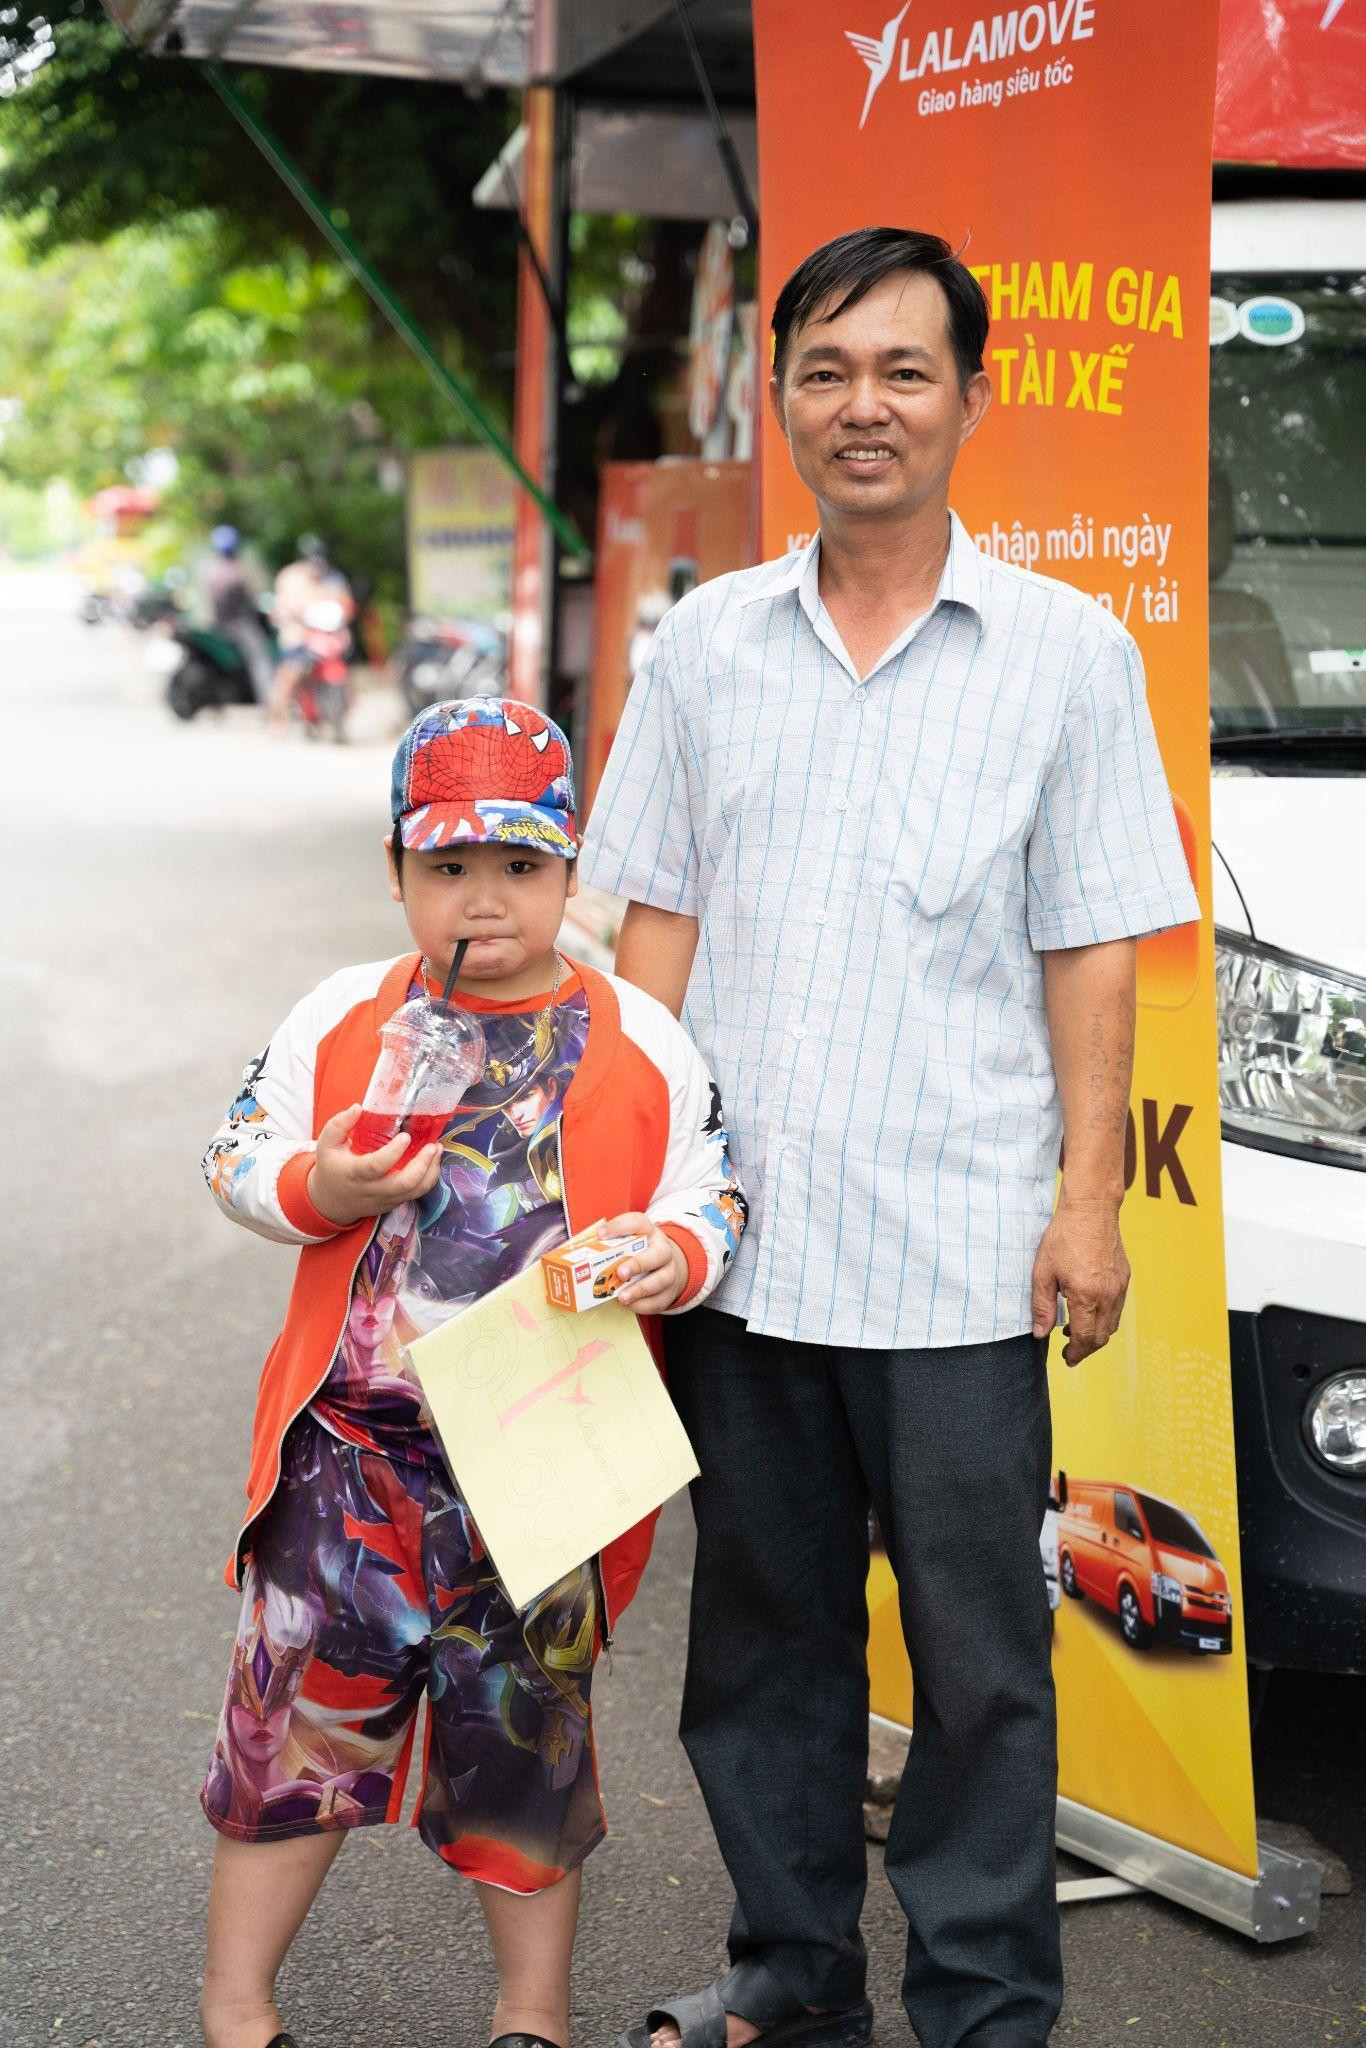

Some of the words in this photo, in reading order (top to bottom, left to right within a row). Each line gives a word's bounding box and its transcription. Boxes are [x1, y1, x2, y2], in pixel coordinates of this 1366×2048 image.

[899, 0, 1096, 82] LALAMOVE
[917, 86, 956, 116] Giao
[960, 79, 1003, 107] hàng
[1006, 66, 1040, 97] siêu
[1045, 56, 1074, 88] tốc
[1106, 266, 1184, 340] GIA
[992, 333, 1056, 407] TÀI
[1046, 513, 1094, 560] mỗi
[1103, 513, 1172, 567] ngày
[1142, 576, 1178, 623] tải
